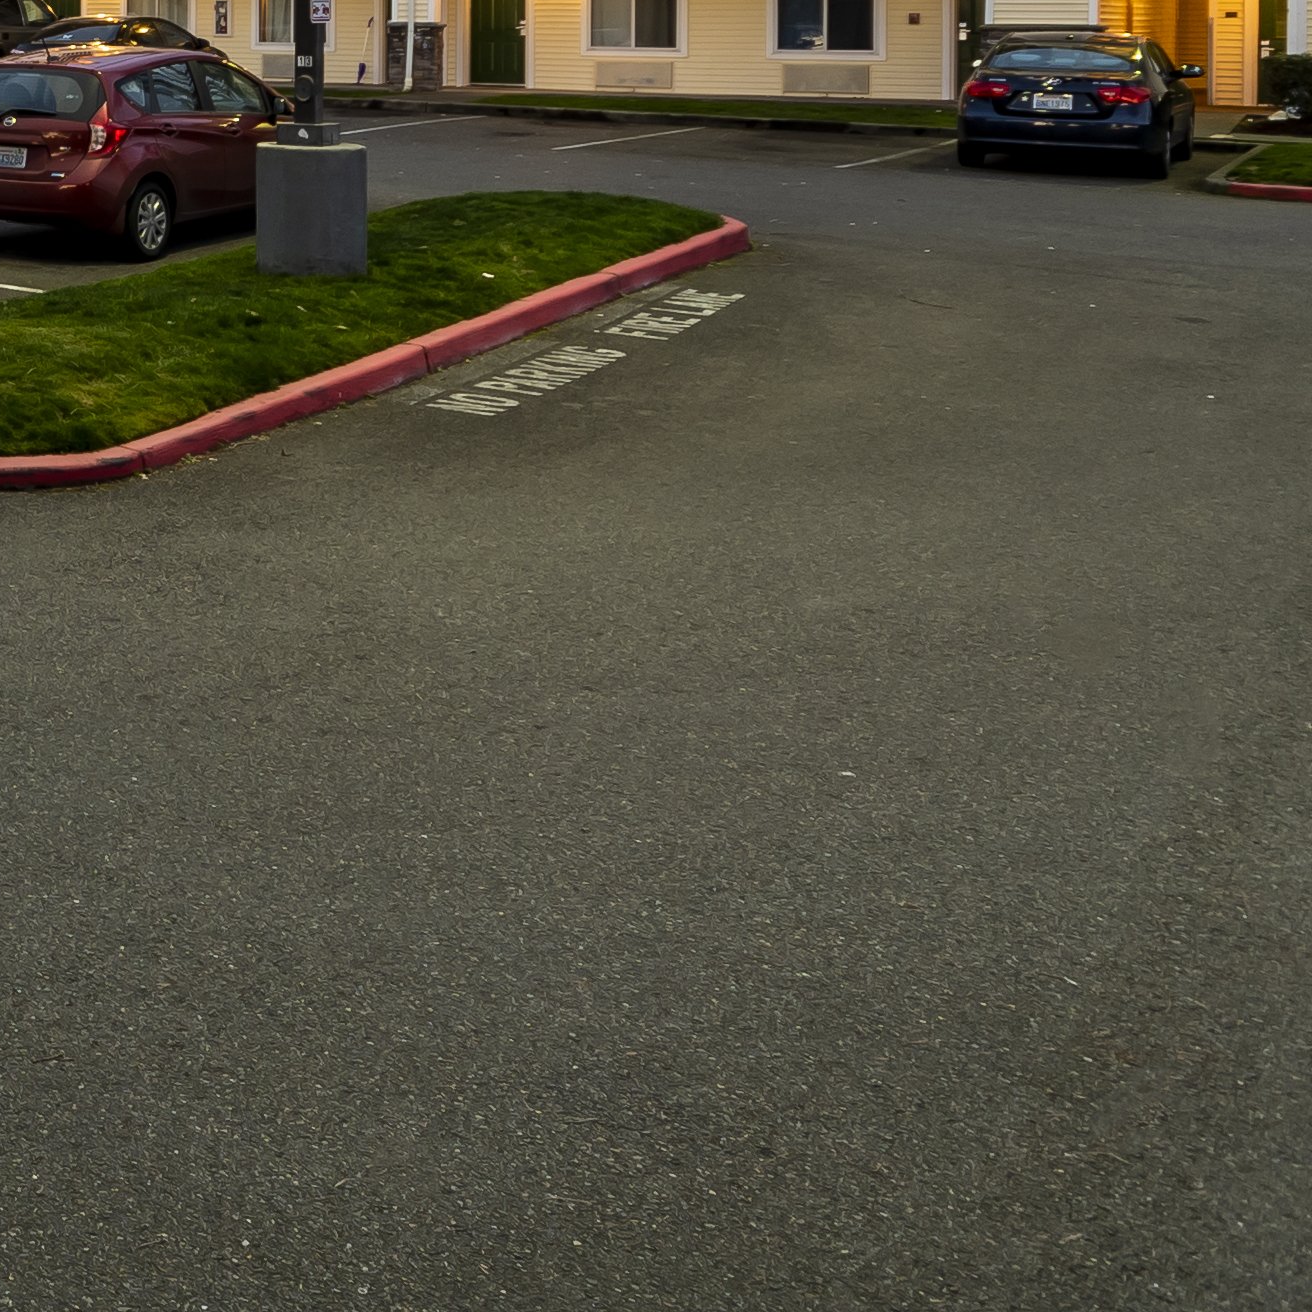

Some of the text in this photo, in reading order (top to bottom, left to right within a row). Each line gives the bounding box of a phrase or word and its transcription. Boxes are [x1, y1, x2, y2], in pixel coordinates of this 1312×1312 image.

[298, 56, 313, 67] 13
[426, 287, 746, 416] NO PARKING FIRE LANE
